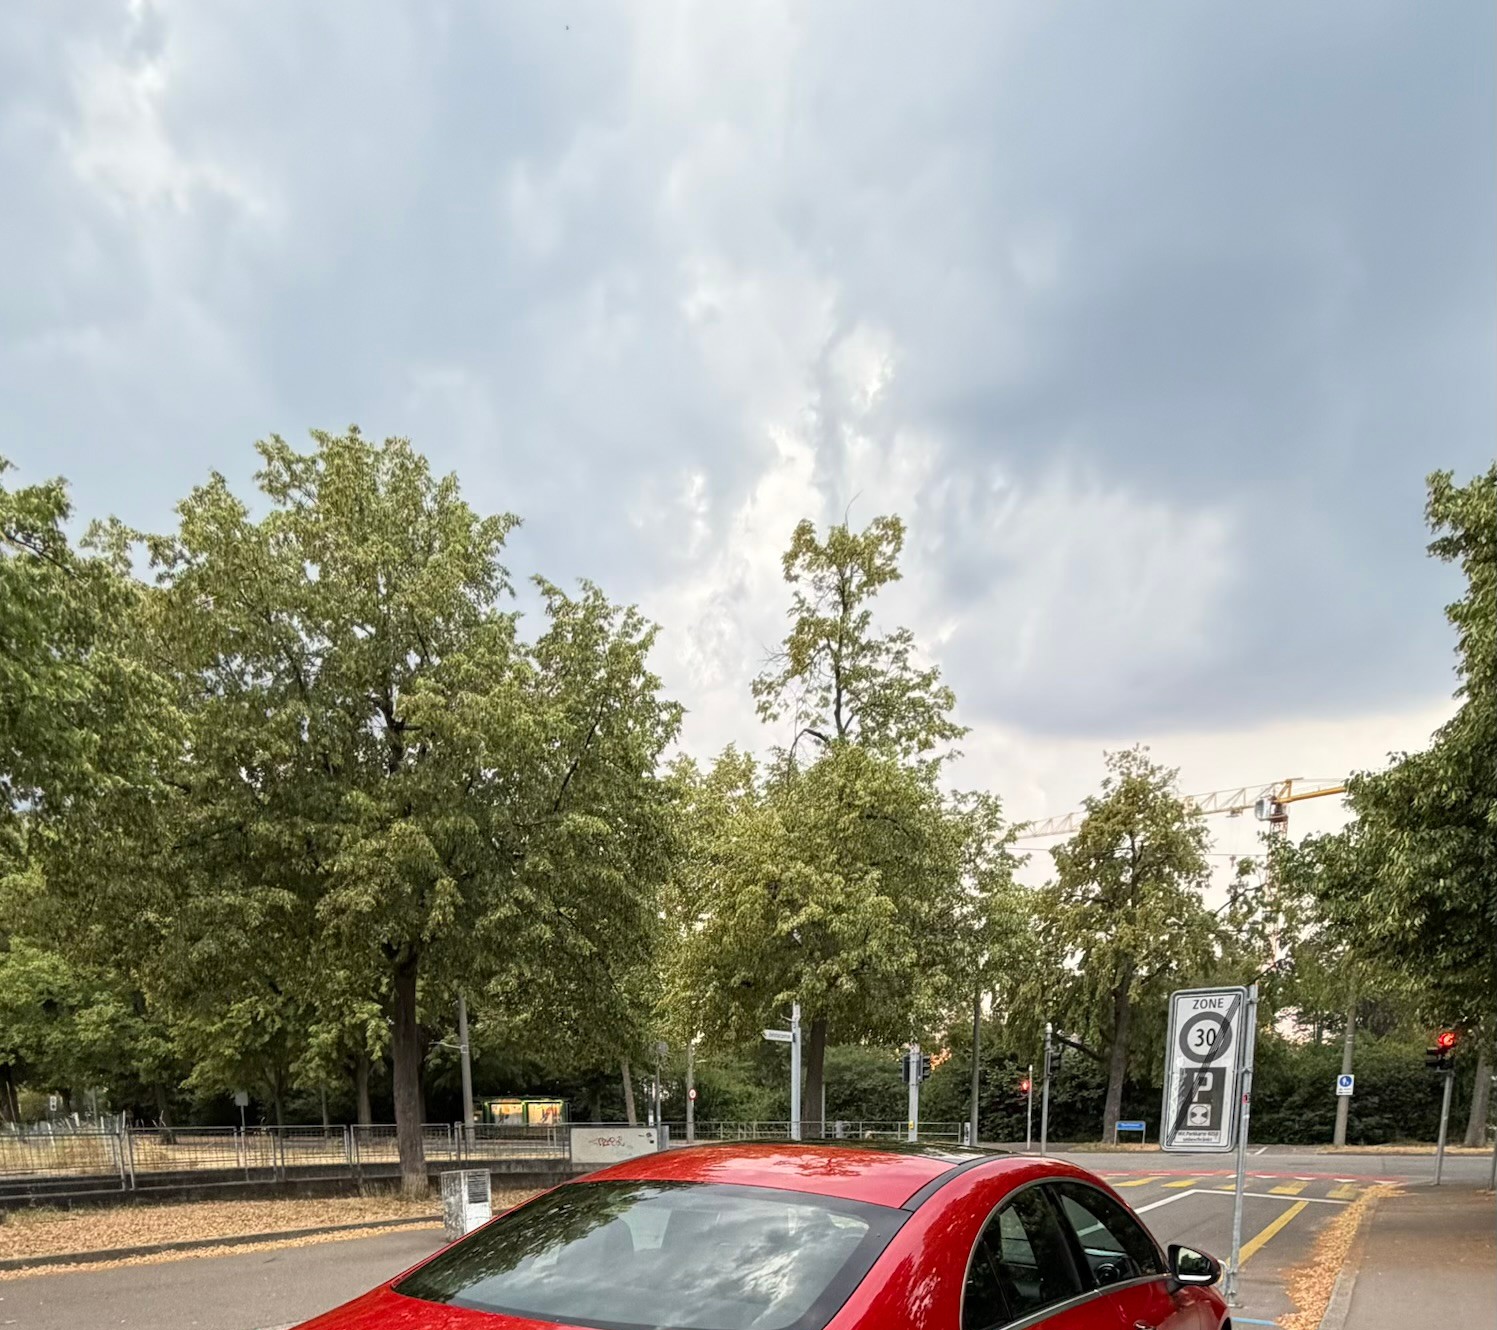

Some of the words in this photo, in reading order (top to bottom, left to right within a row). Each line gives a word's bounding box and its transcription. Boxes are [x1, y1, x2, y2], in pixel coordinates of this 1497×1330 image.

[1192, 998, 1225, 1010] ZONE
[1194, 1028, 1216, 1047] 30
[1192, 1072, 1213, 1102] P
